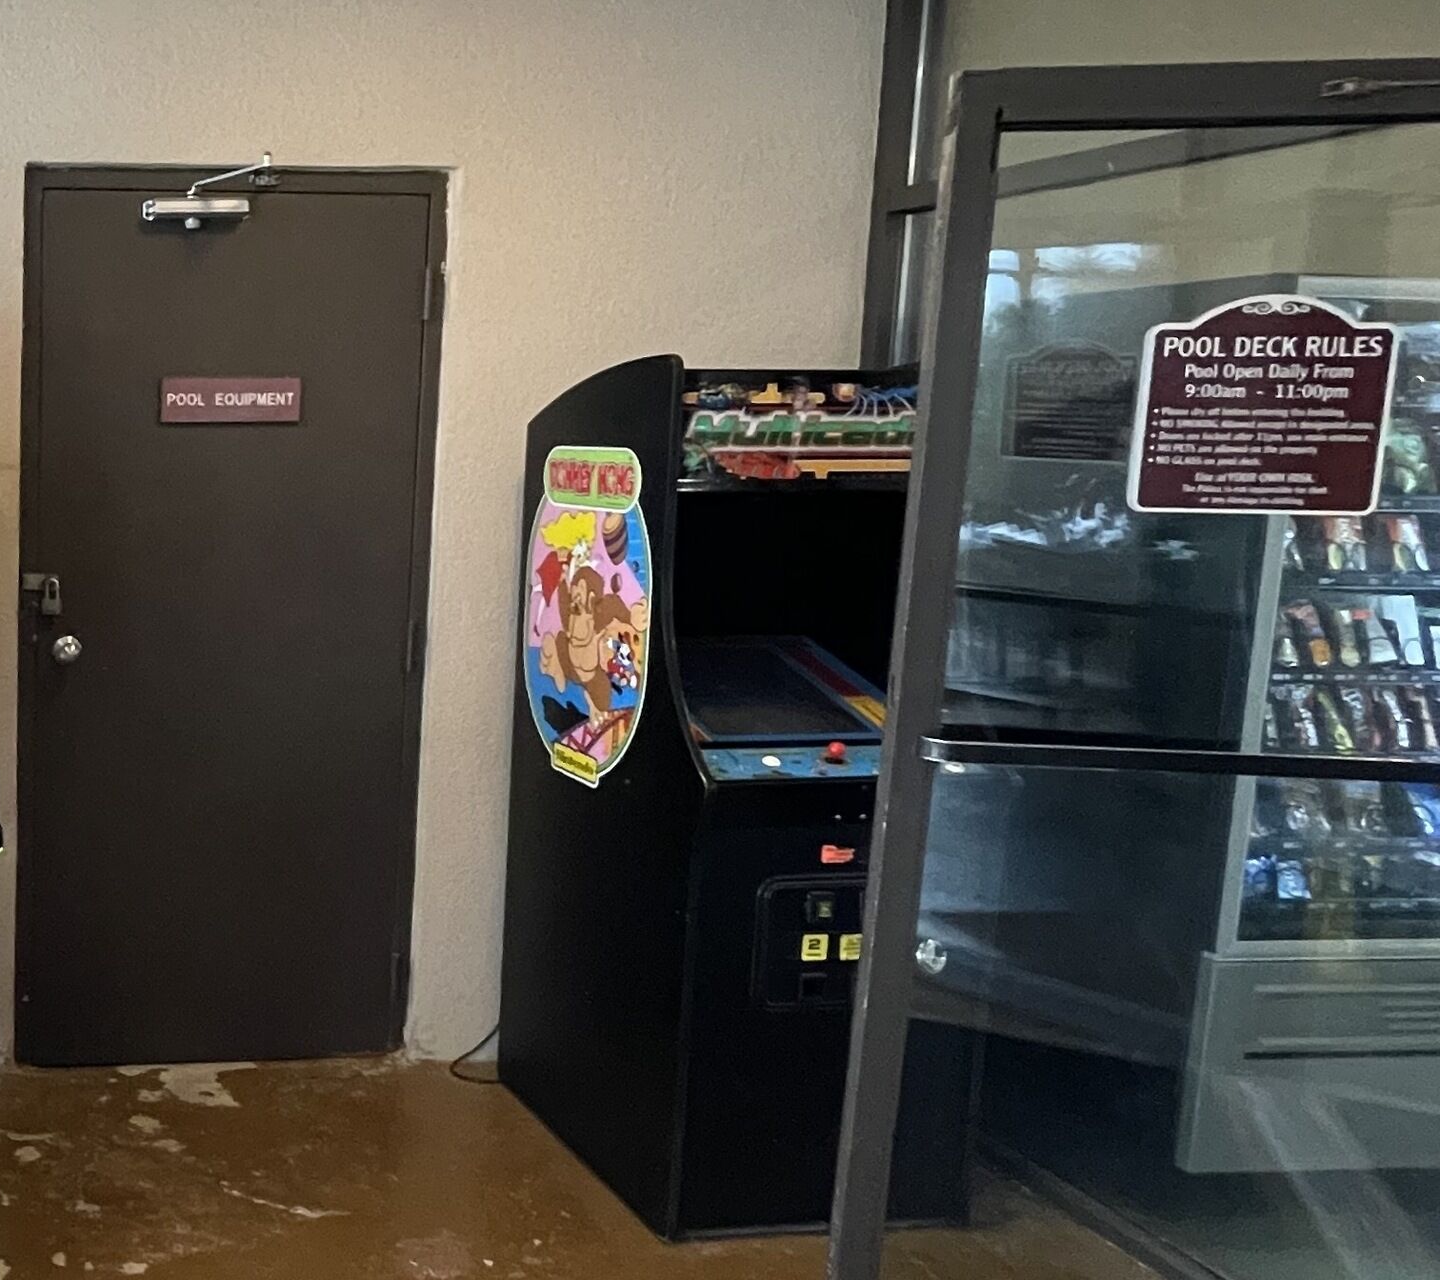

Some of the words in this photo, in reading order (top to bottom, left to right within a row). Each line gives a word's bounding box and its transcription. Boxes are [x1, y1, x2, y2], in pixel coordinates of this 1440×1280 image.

[1163, 335, 1226, 358] POOL
[1234, 335, 1298, 358] DECK
[1305, 334, 1384, 358] RULES
[1184, 363, 1219, 380] Pool
[1223, 363, 1264, 381] Open
[1268, 363, 1310, 382] Daily
[1313, 363, 1355, 380] From
[166, 392, 206, 407] POOL
[215, 391, 295, 407] EQUIPMENT
[1184, 383, 1248, 399] 9:00am
[1274, 383, 1350, 402] 11:00pm
[691, 412, 912, 447] Multicad
[550, 459, 595, 496] DONKEY
[597, 463, 635, 498] KONG
[808, 938, 821, 950] 2
